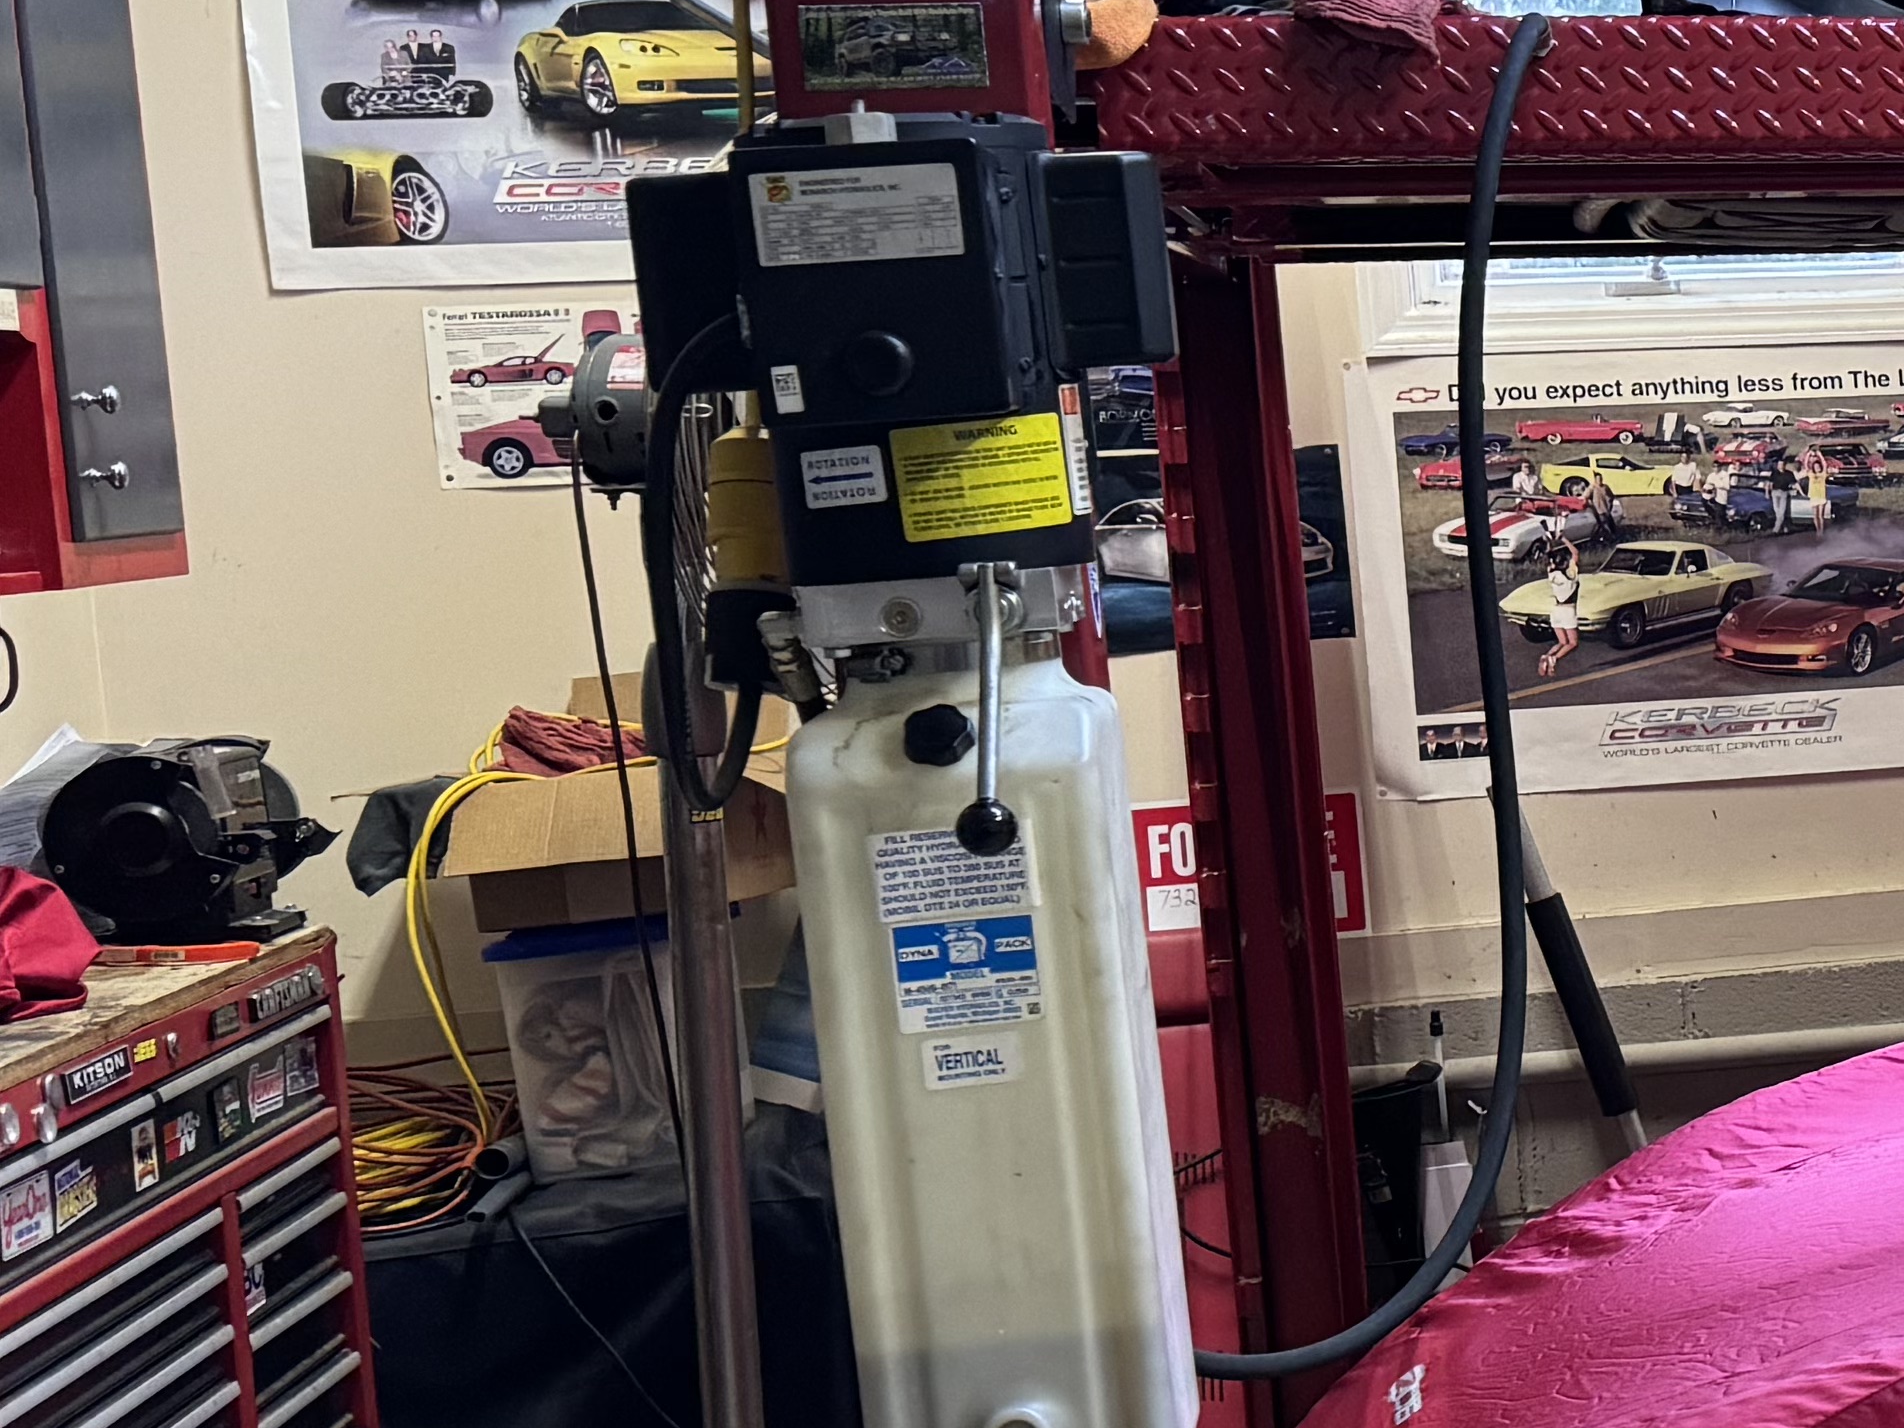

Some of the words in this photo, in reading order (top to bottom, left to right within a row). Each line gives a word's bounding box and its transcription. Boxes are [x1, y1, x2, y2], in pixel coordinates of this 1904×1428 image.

[1495, 384, 1537, 407] you
[1545, 378, 1624, 404] expect
[1630, 373, 1730, 401] anything
[1736, 371, 1785, 394] less
[1791, 370, 1844, 392] from
[1848, 368, 1891, 391] The
[953, 424, 1018, 442] WARNING
[806, 455, 870, 470] ROTATION
[811, 487, 877, 502] ROTATION
[1606, 697, 1842, 727] KERBECK
[1608, 715, 1828, 742] CORVETTE
[1664, 742, 1722, 755] LARGEST
[1726, 738, 1791, 753] CORVETTE
[1794, 734, 1844, 747] DEALER
[884, 831, 908, 846] FILL
[876, 842, 924, 859] QUALITY
[874, 856, 917, 871] HAVING
[918, 855, 928, 867] A
[883, 871, 900, 883] OF
[946, 864, 962, 876] TO
[983, 860, 1007, 873] SUS
[1007, 858, 1022, 871] AT
[914, 876, 947, 891] FLUID
[947, 869, 1027, 888] TEMPERATURE
[880, 892, 928, 907] SHOULD
[929, 888, 953, 901] NOT
[954, 884, 1000, 898] EXCEED
[883, 904, 923, 919] (MOBIL
[924, 900, 947, 913] DTE
[962, 897, 981, 910] OR
[980, 894, 1022, 908] EQUAL)
[899, 947, 937, 961] DYNA
[995, 937, 1032, 951] PACK
[72, 1051, 125, 1090] KITSON
[934, 1047, 1004, 1073] VERTICAL
